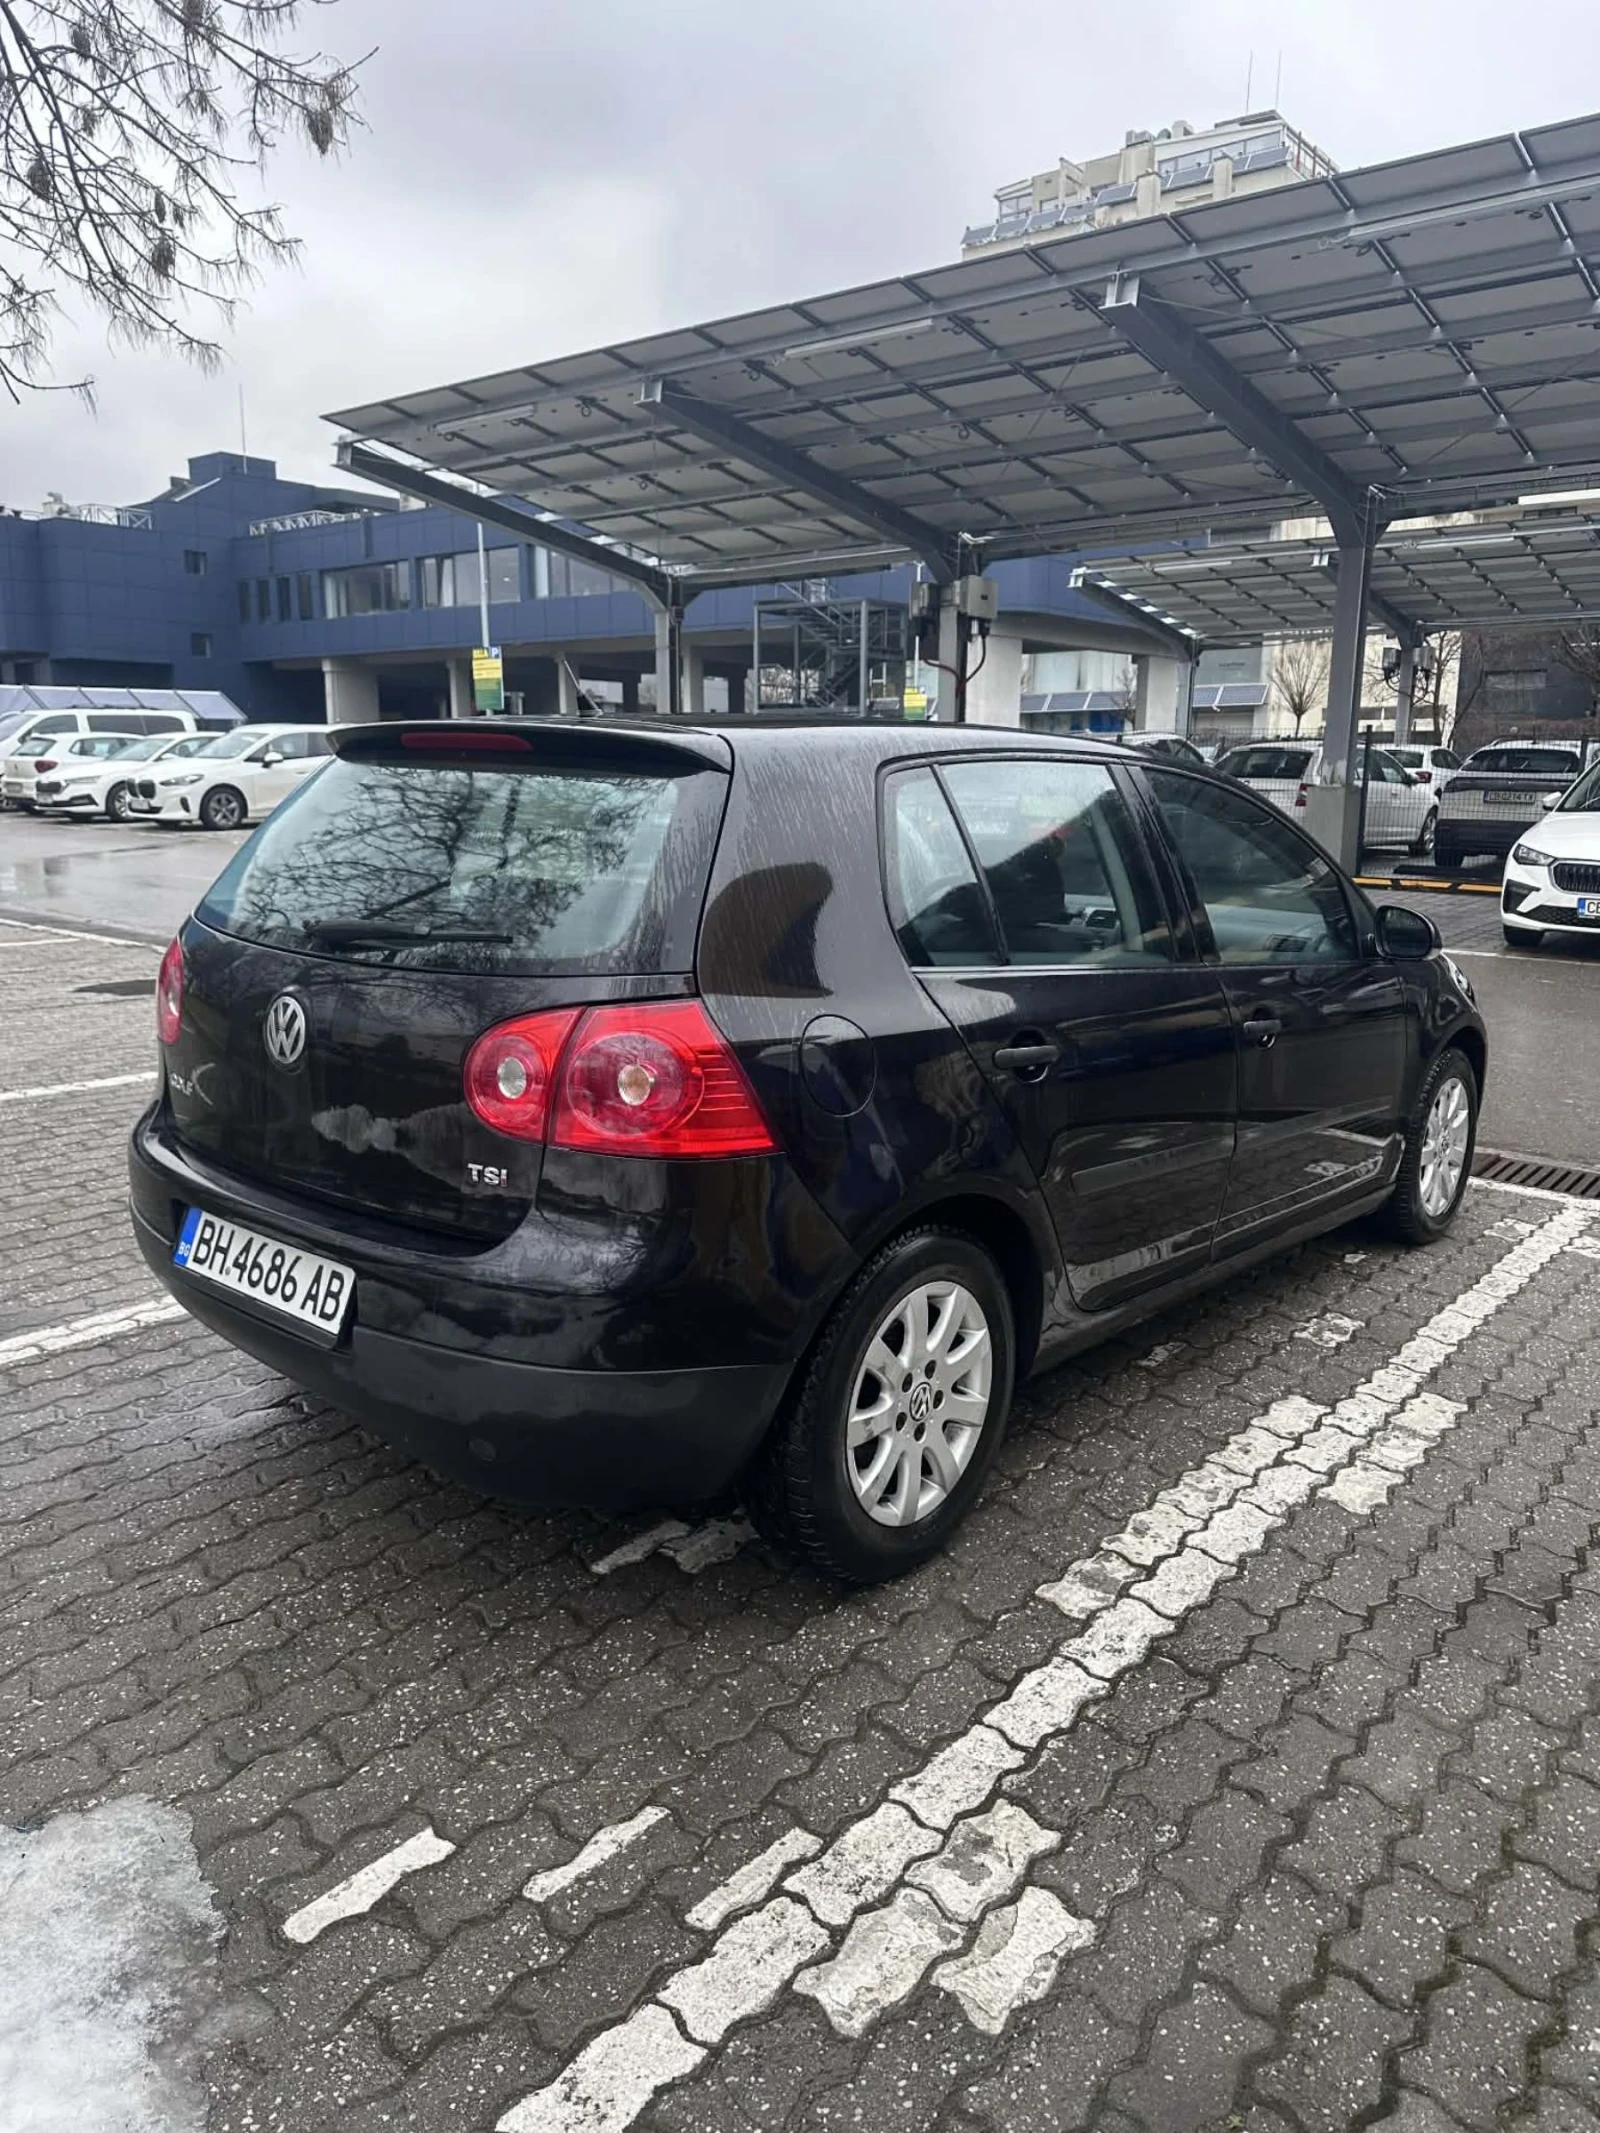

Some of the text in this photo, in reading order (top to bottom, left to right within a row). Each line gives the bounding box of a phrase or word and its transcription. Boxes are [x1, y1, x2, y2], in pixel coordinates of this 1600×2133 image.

[467, 1162, 508, 1187] TSI
[178, 1241, 191, 1257] BG
[300, 1264, 344, 1321] AB
